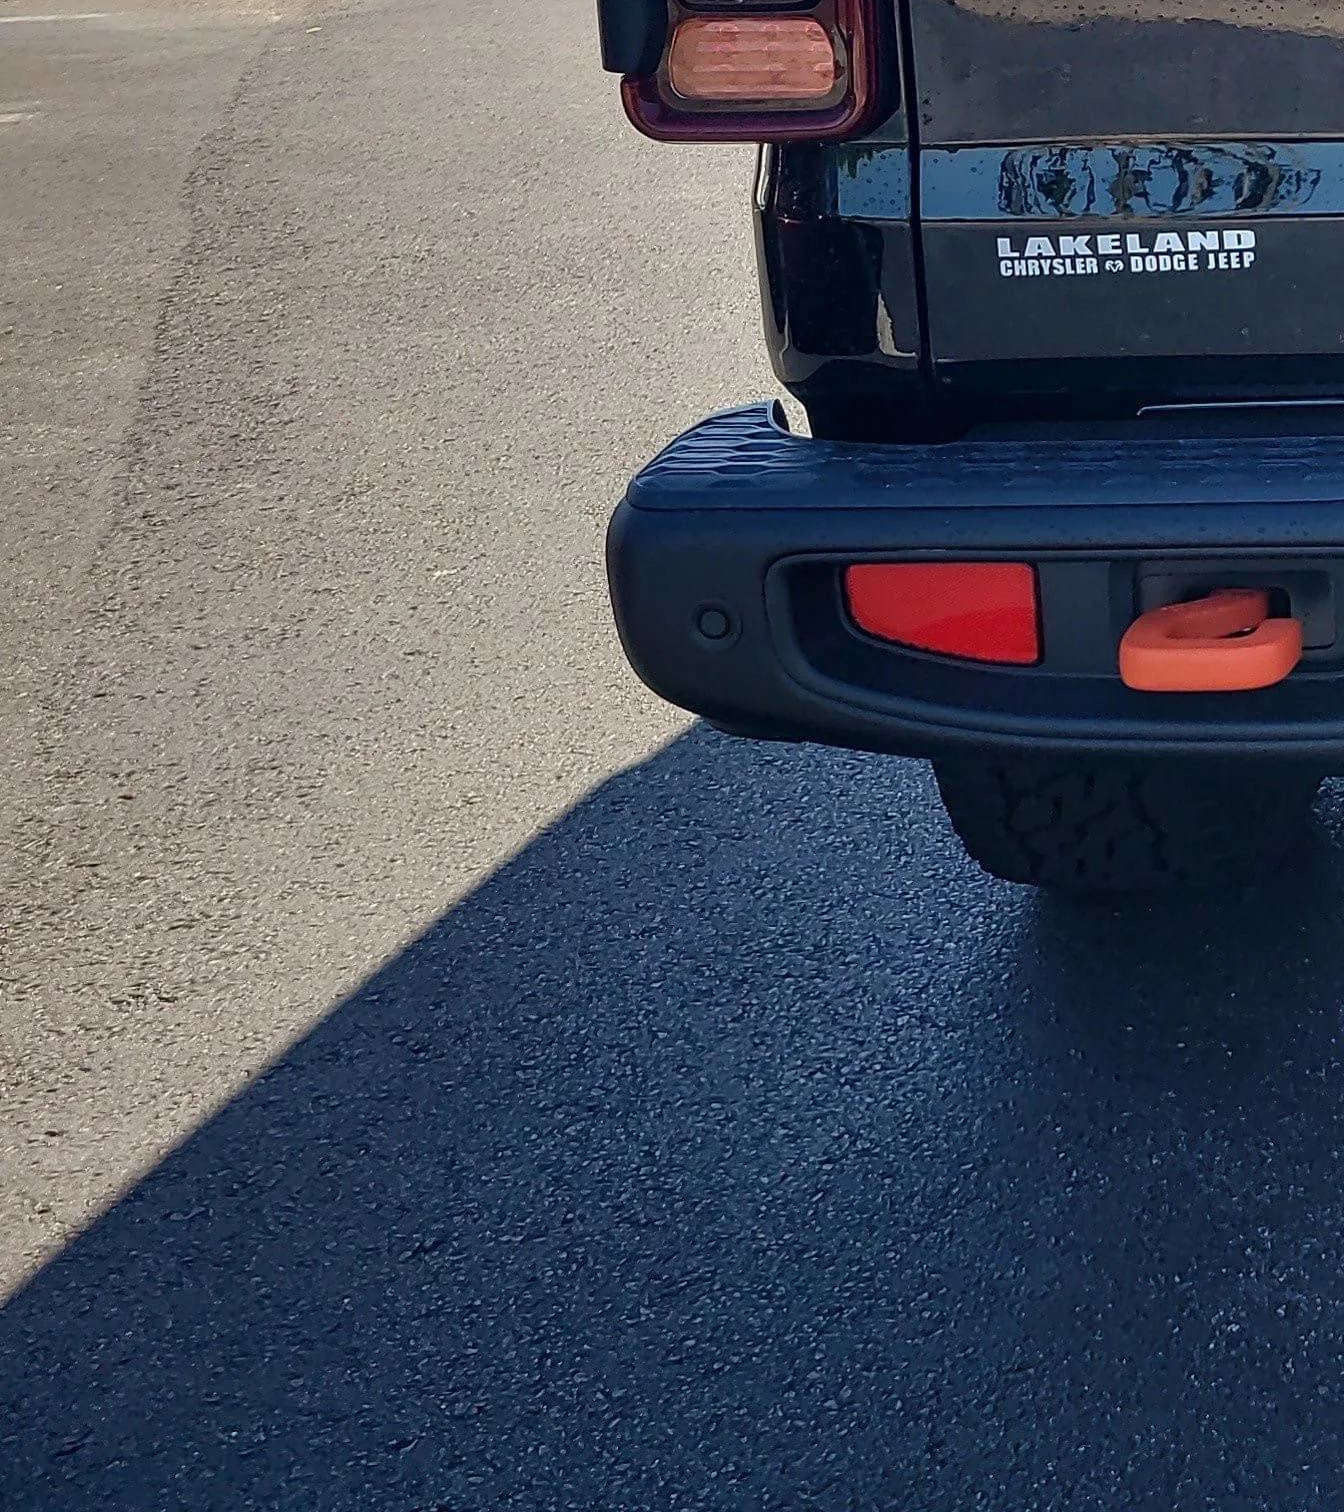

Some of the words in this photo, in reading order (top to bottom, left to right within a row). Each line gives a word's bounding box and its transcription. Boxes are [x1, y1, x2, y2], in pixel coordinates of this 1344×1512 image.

[996, 229, 1256, 258] LAKELAND
[999, 257, 1099, 277] CHRYSLER
[1130, 253, 1200, 273] DODGE
[1207, 251, 1256, 271] JEEP
